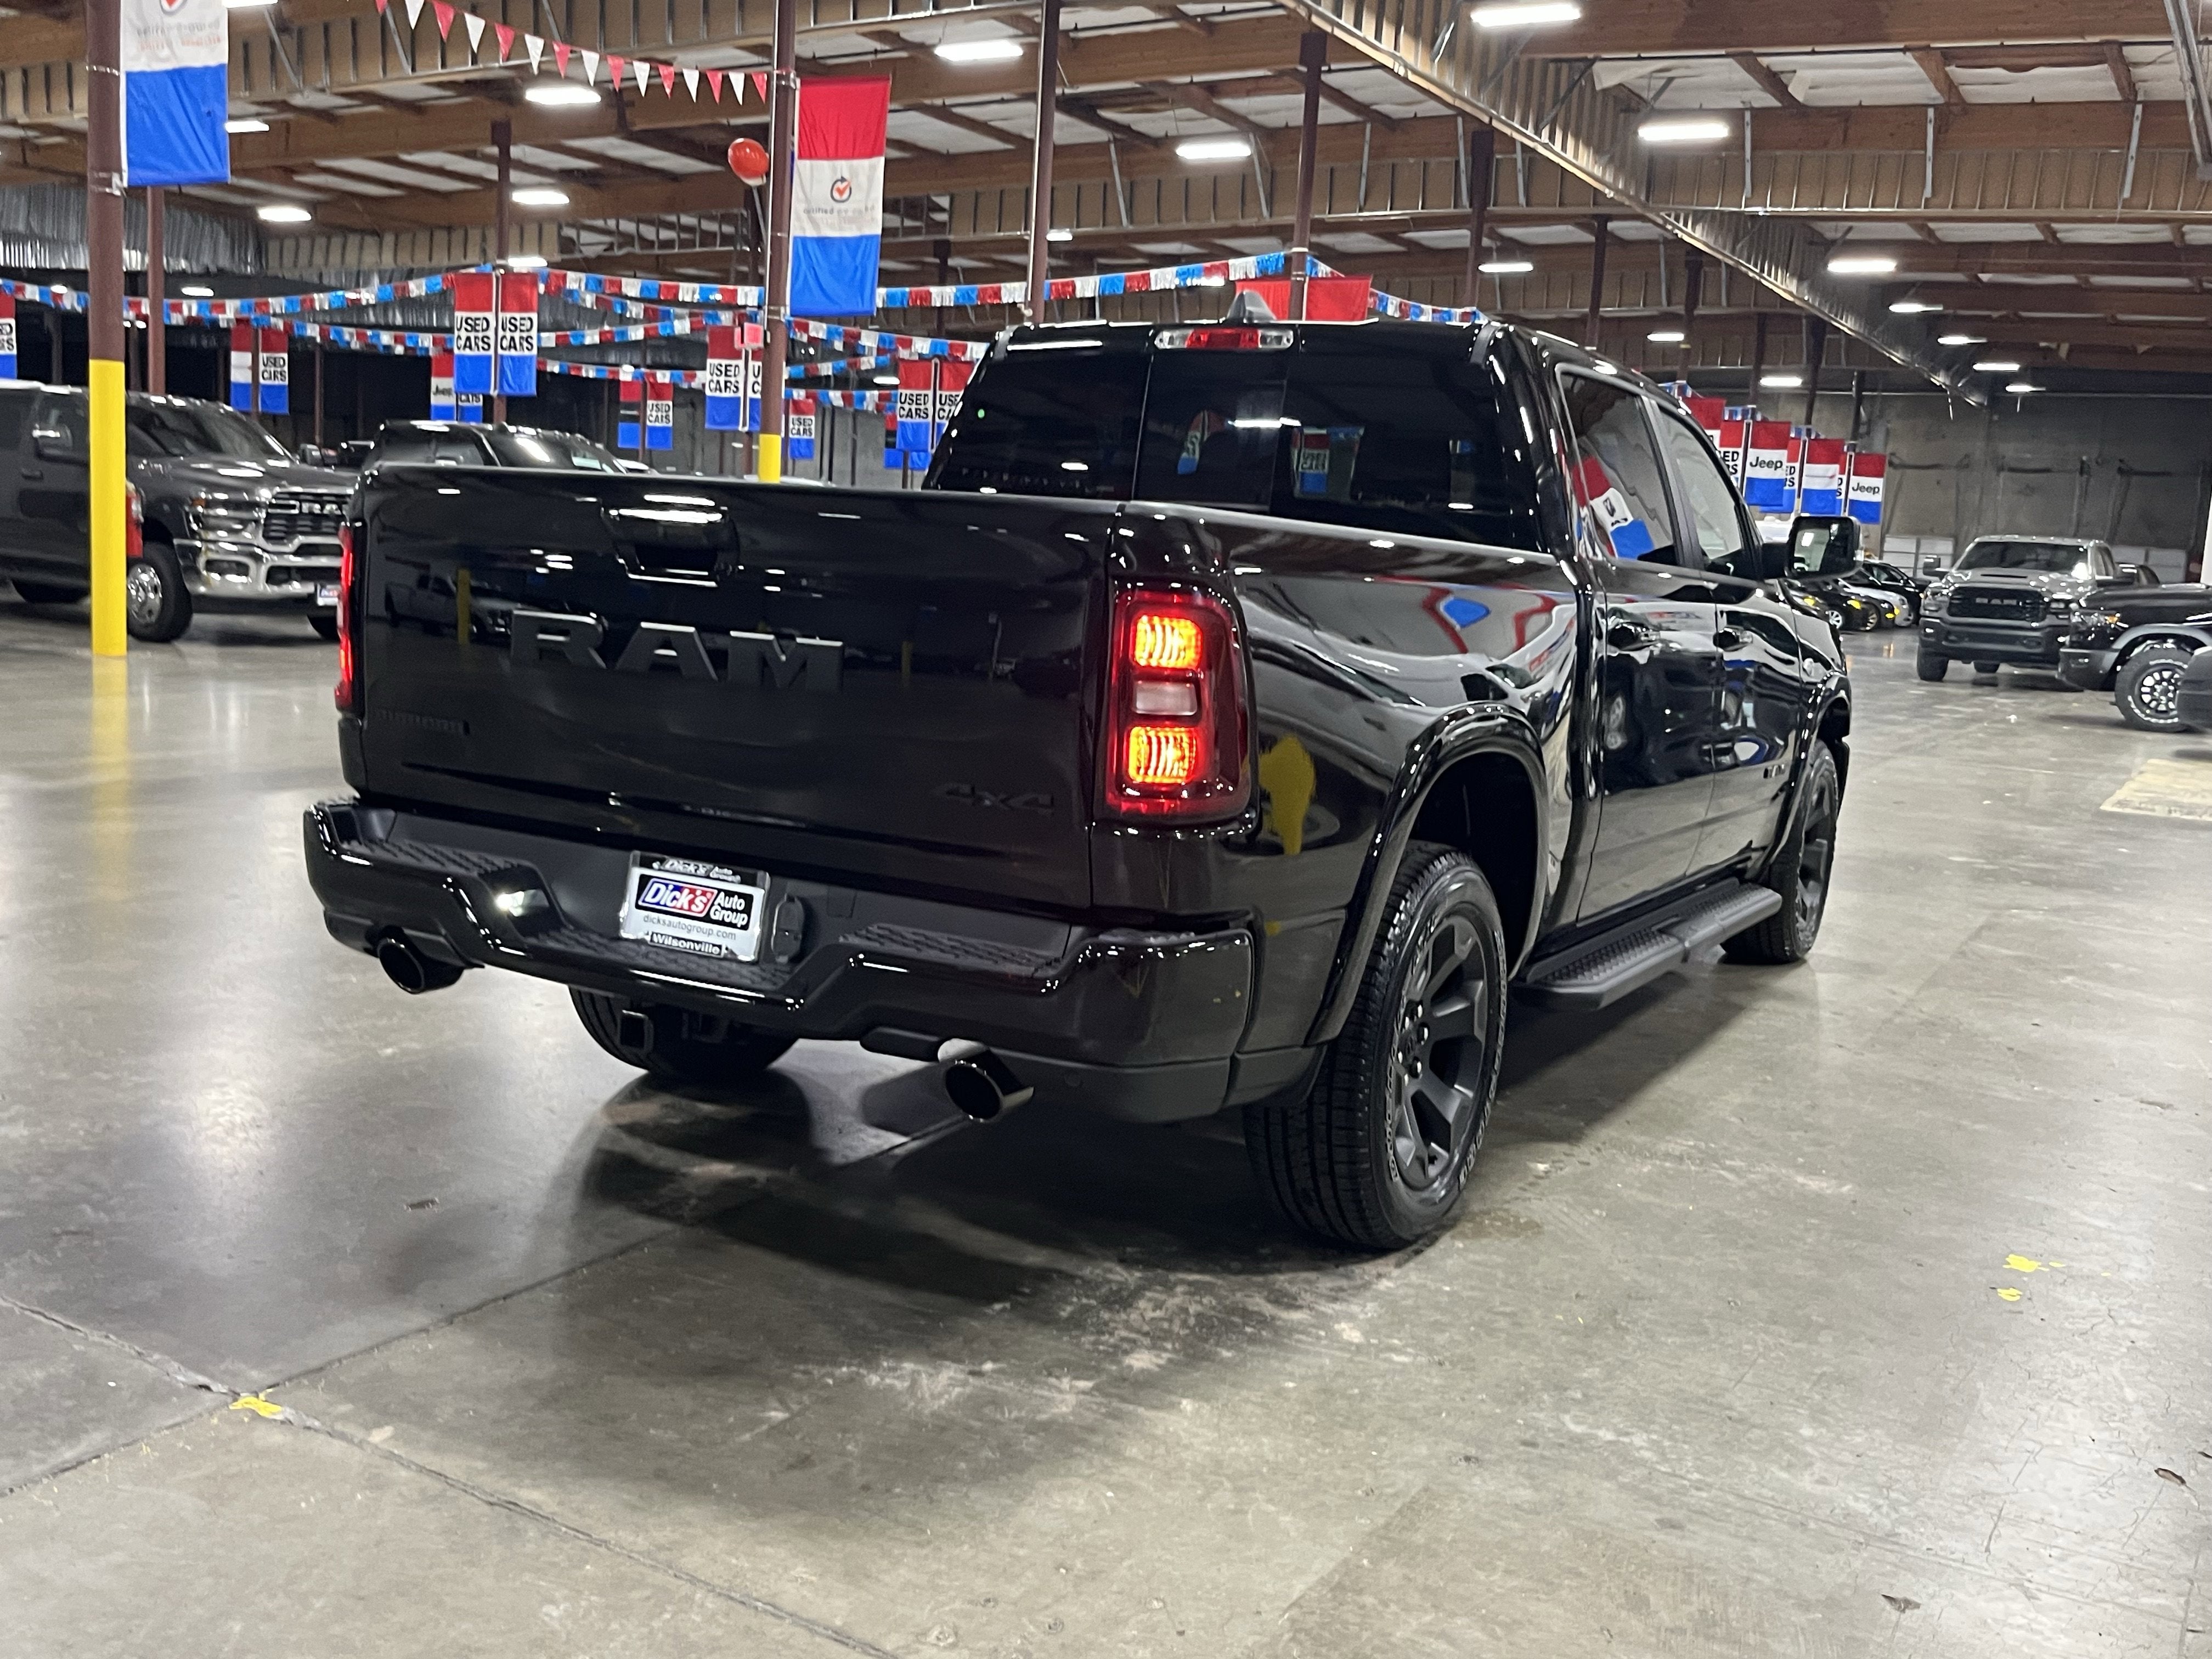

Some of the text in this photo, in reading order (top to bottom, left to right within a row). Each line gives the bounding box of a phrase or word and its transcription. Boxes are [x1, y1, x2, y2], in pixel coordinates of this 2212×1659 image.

[456, 317, 490, 332] USED
[501, 317, 534, 332] USED
[456, 335, 491, 351] CARS
[500, 335, 534, 351] CARS
[262, 356, 286, 368] USED
[262, 370, 286, 381] CARS
[709, 363, 740, 377] USED
[708, 380, 740, 393] CARS
[899, 392, 929, 405] USED
[939, 393, 960, 407] USE
[648, 403, 670, 413] USED
[899, 407, 929, 419] CARS
[792, 417, 813, 426] USED
[791, 427, 813, 436] CARS
[1750, 456, 1783, 471] Jeep
[1852, 483, 1880, 495] Jeep
[302, 503, 343, 515] RA
[511, 610, 845, 691] RAM
[644, 882, 708, 913] Dick's
[714, 891, 746, 911] Auto
[709, 905, 748, 928] Group
[644, 915, 736, 940] dicksautogroup.com
[652, 933, 720, 955] Wilsonville
